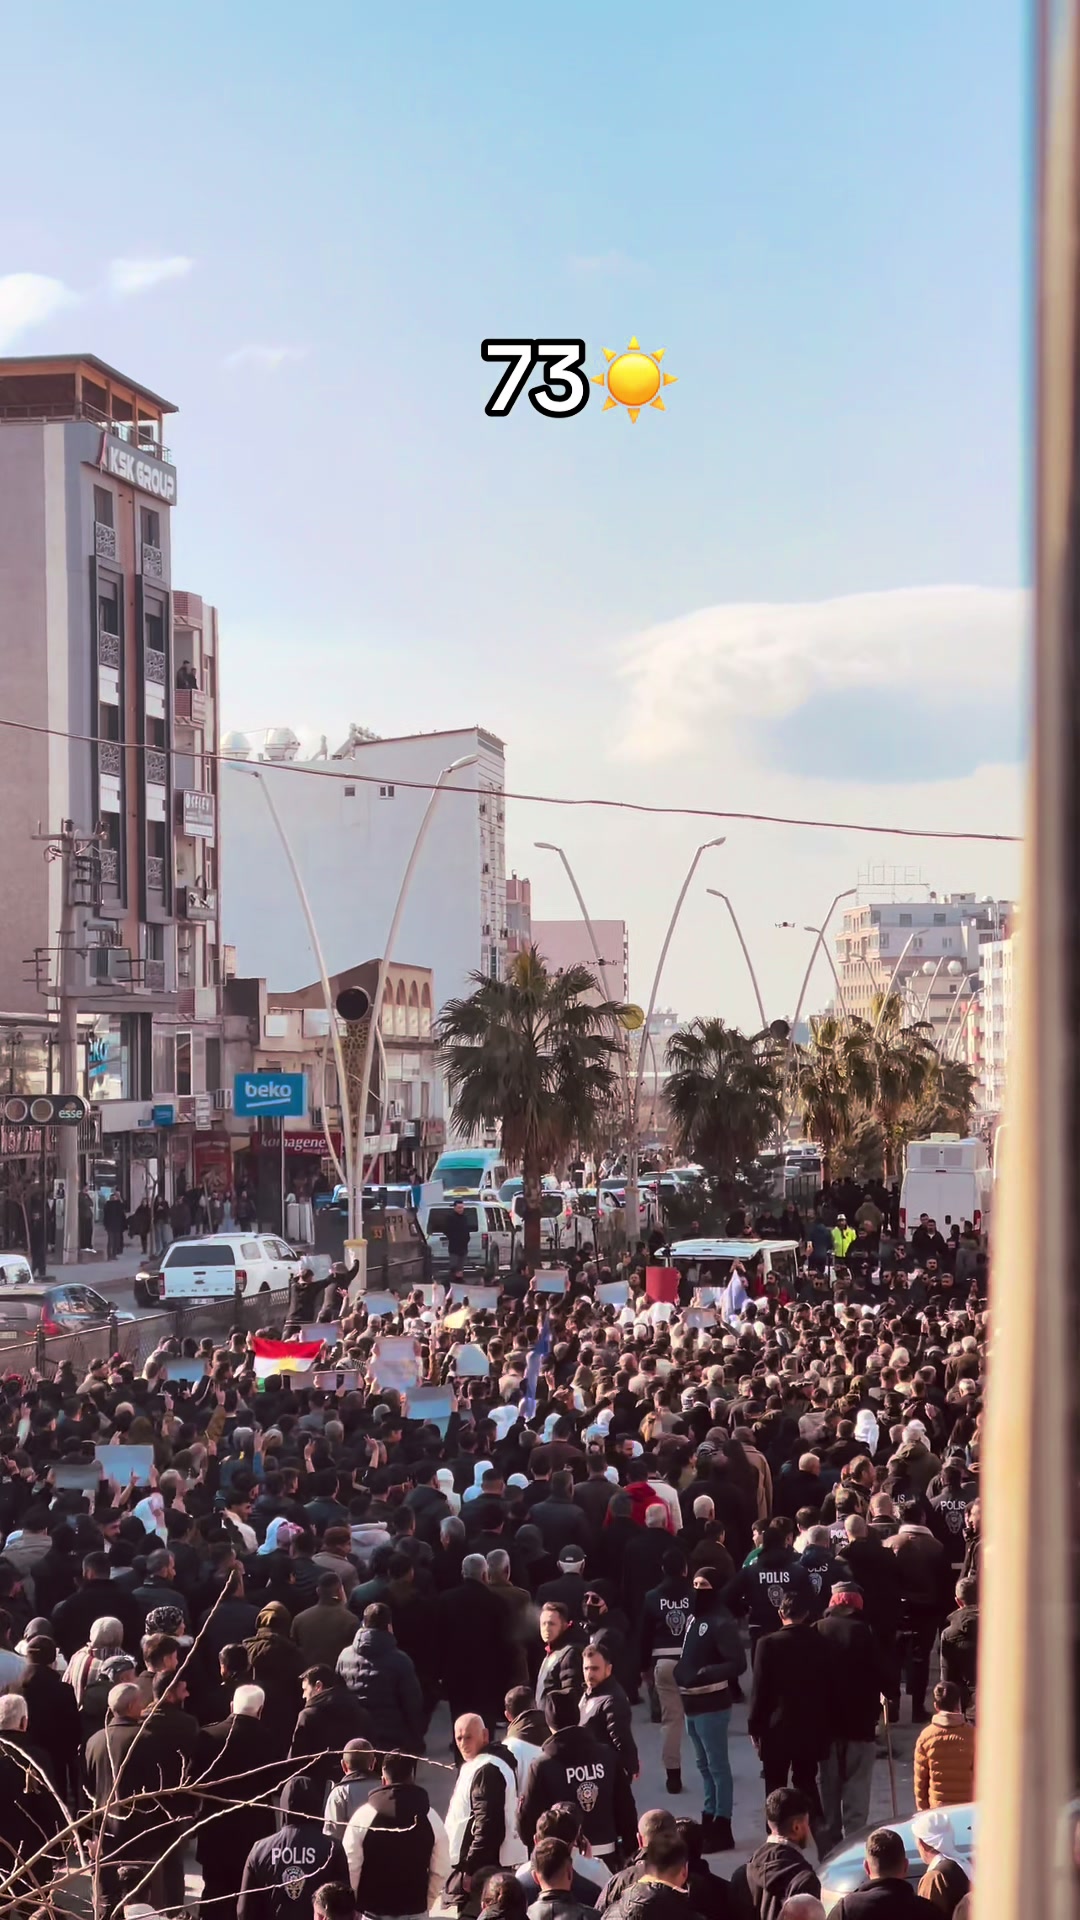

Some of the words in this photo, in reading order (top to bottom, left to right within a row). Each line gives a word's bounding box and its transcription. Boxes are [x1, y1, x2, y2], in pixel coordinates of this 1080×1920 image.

[110, 446, 135, 483] KSK
[136, 461, 175, 499] GROUP
[245, 1081, 292, 1097] beko
[58, 1109, 83, 1119] esse
[940, 1500, 967, 1511] POLIS
[759, 1571, 790, 1584] POLIS
[565, 1763, 605, 1784] POLIS
[271, 1846, 316, 1866] POLIS
